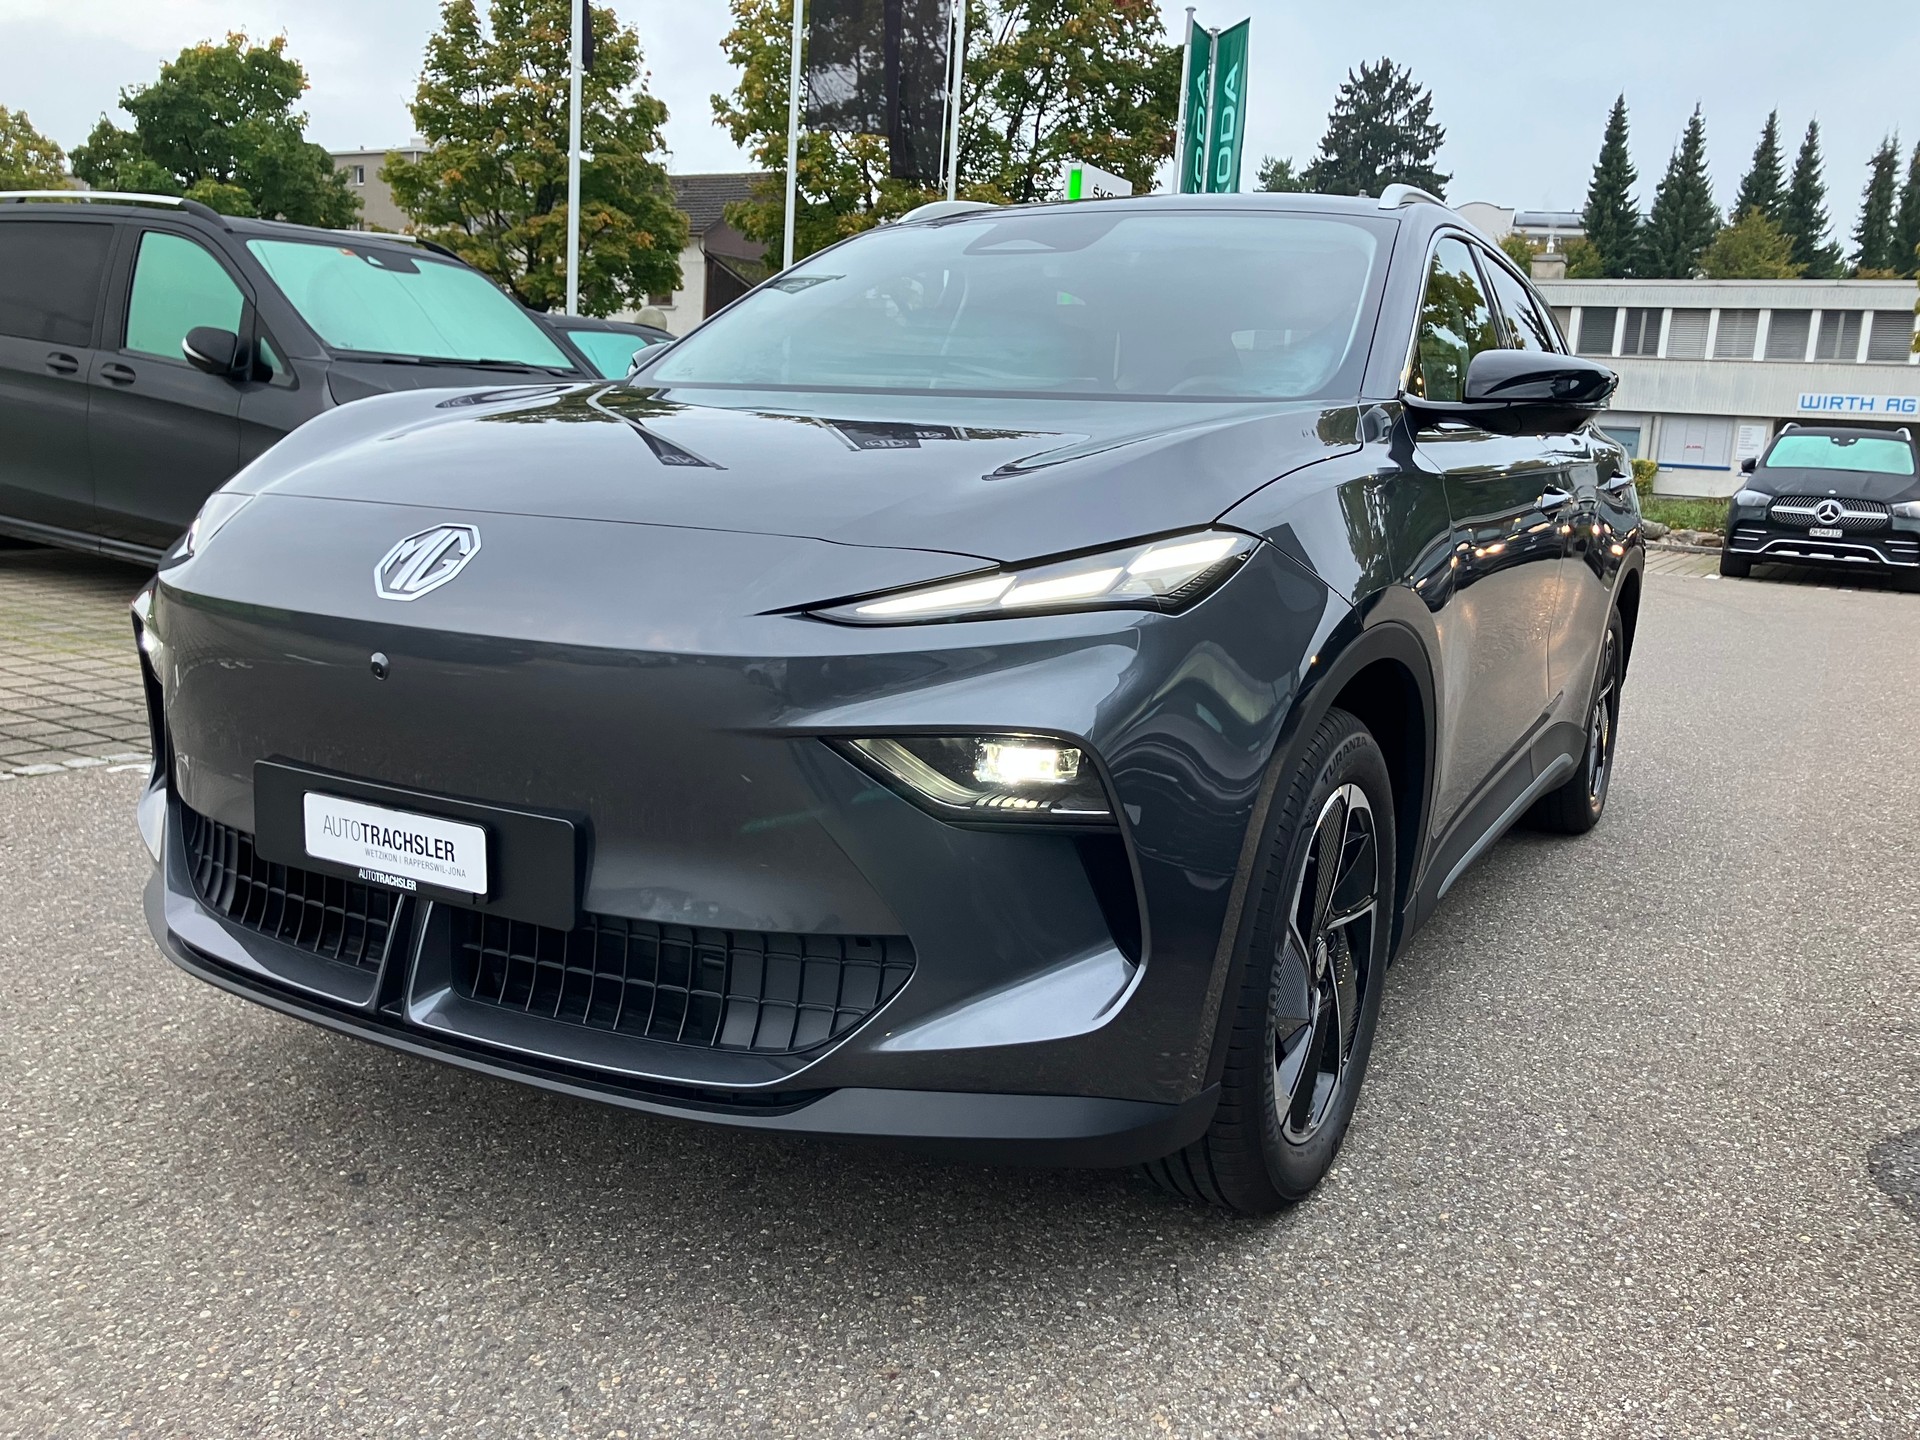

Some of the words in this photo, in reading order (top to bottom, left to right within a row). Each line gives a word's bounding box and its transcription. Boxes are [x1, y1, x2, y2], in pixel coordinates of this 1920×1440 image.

[1801, 395, 1875, 411] WIRTH
[1886, 398, 1917, 412] AG
[379, 526, 477, 598] MG
[1321, 736, 1368, 785] TURANZA
[323, 814, 455, 863] AUTOTRACHSLER
[358, 868, 417, 891] AUTOTRACHSLER
[364, 848, 398, 863] WETZIKON
[403, 856, 467, 879] RAPPERSWIL-JONA
